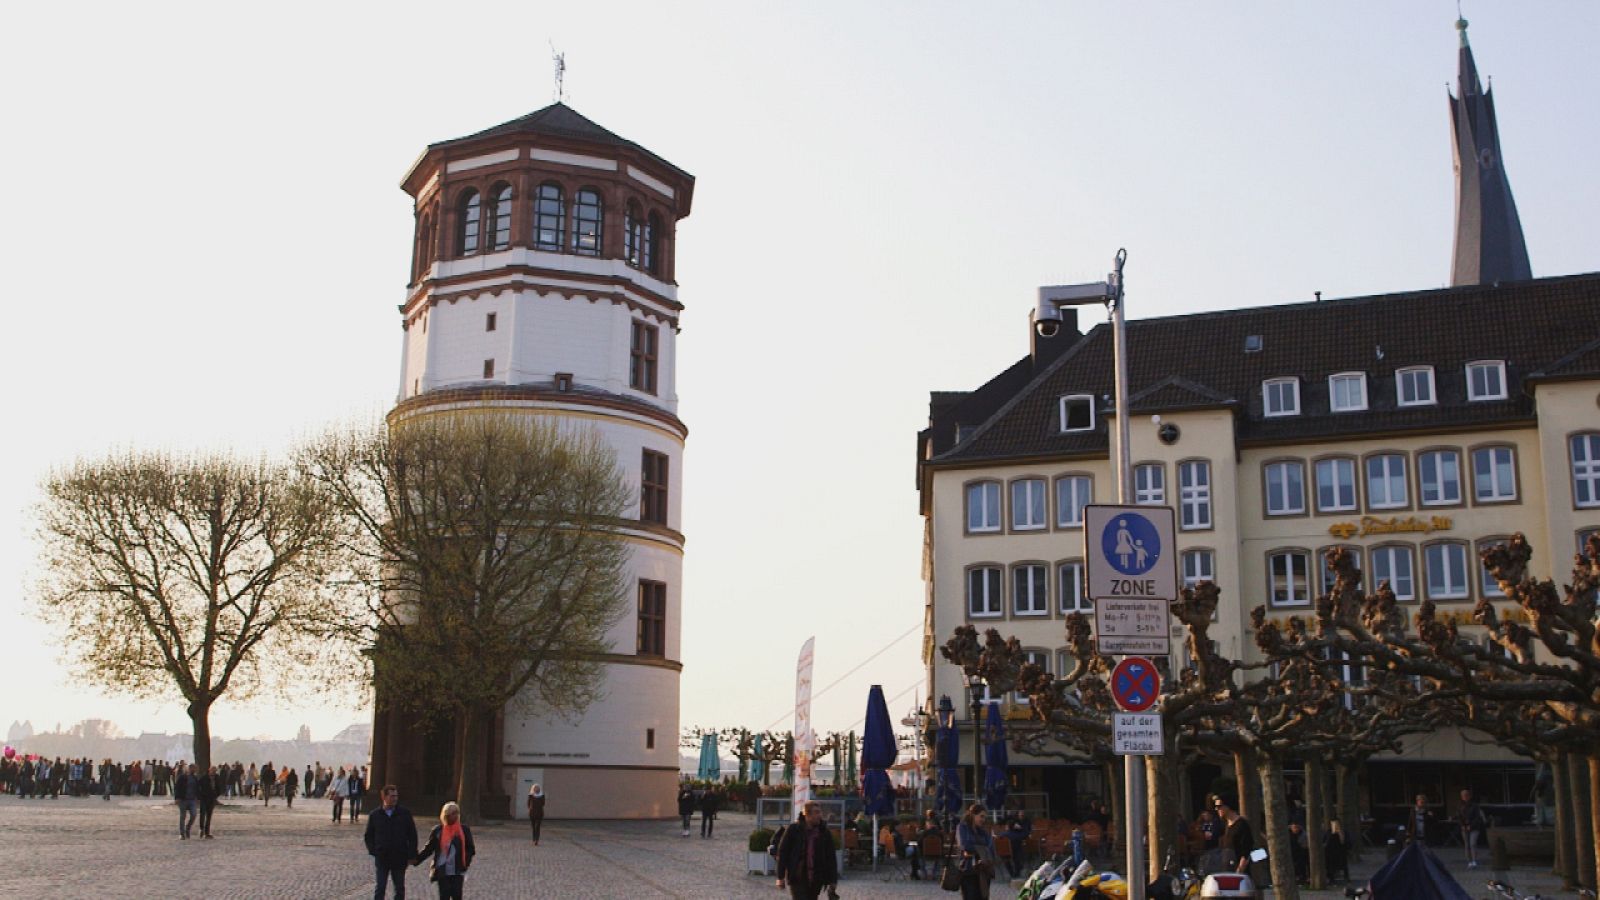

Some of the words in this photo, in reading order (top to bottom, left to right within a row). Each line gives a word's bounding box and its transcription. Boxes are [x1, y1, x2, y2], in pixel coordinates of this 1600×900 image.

[1110, 579, 1156, 595] ZONE
[1104, 613, 1128, 621] Mo-Fr
[1105, 624, 1116, 632] Sa
[1120, 716, 1135, 726] auf
[1139, 716, 1154, 726] der
[1117, 730, 1159, 740] gesamten
